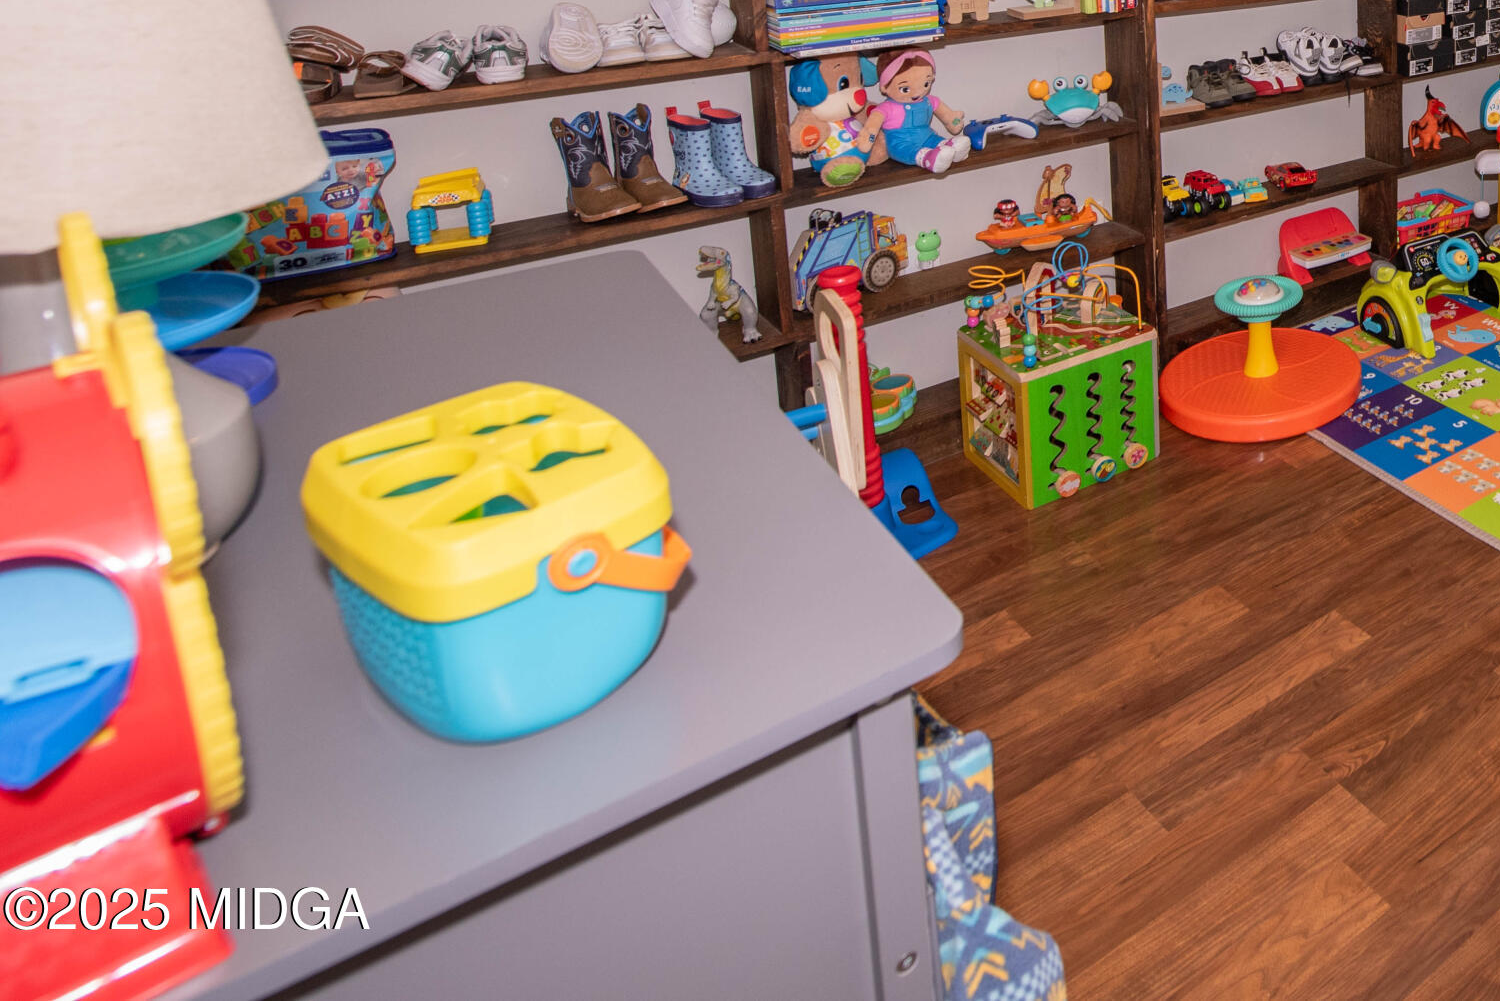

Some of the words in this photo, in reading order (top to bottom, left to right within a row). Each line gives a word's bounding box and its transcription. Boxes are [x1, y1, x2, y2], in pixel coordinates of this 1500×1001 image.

[960, 0, 976, 10] tall
[797, 85, 812, 93] EAR
[279, 257, 308, 271] 30
[1363, 372, 1377, 380] 9
[1404, 394, 1423, 406] 10
[1452, 420, 1468, 429] 5
